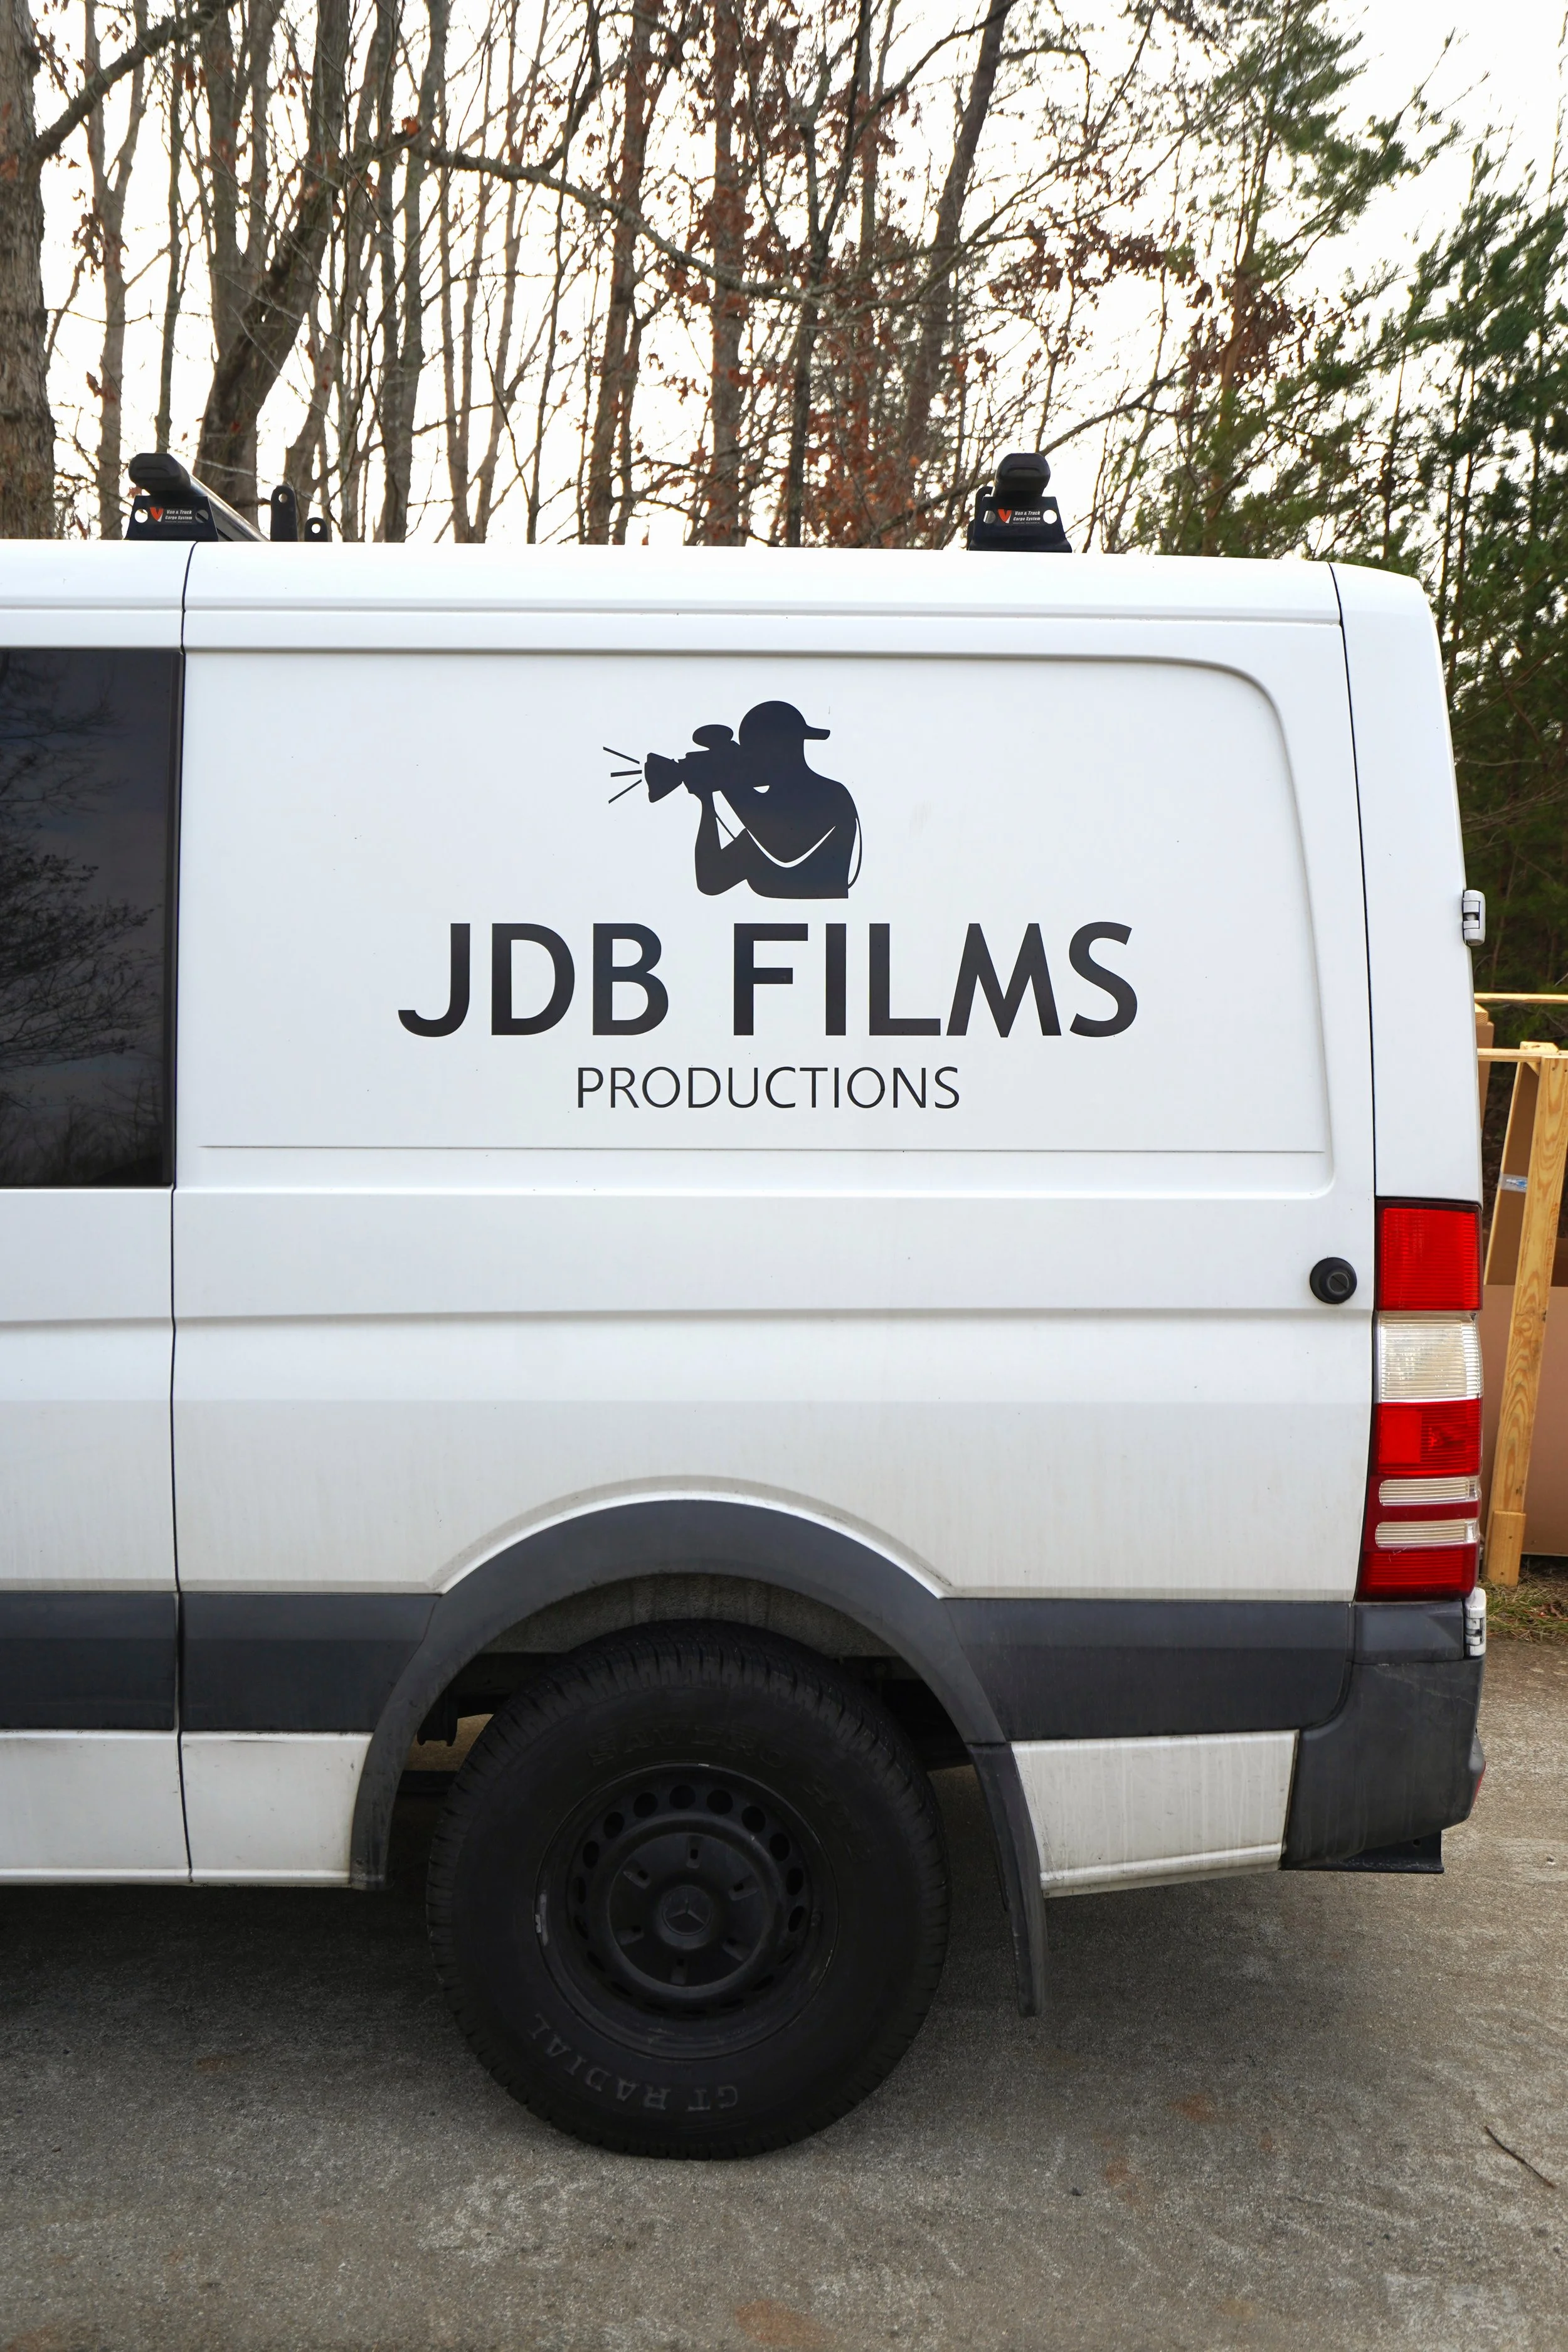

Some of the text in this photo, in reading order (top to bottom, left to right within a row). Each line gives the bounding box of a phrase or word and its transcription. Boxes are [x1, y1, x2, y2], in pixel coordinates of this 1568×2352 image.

[398, 921, 1138, 1038] JDB FILMS
[578, 1066, 960, 1109] PRODUCTIONS
[527, 2012, 738, 2112] GT RADIAL
